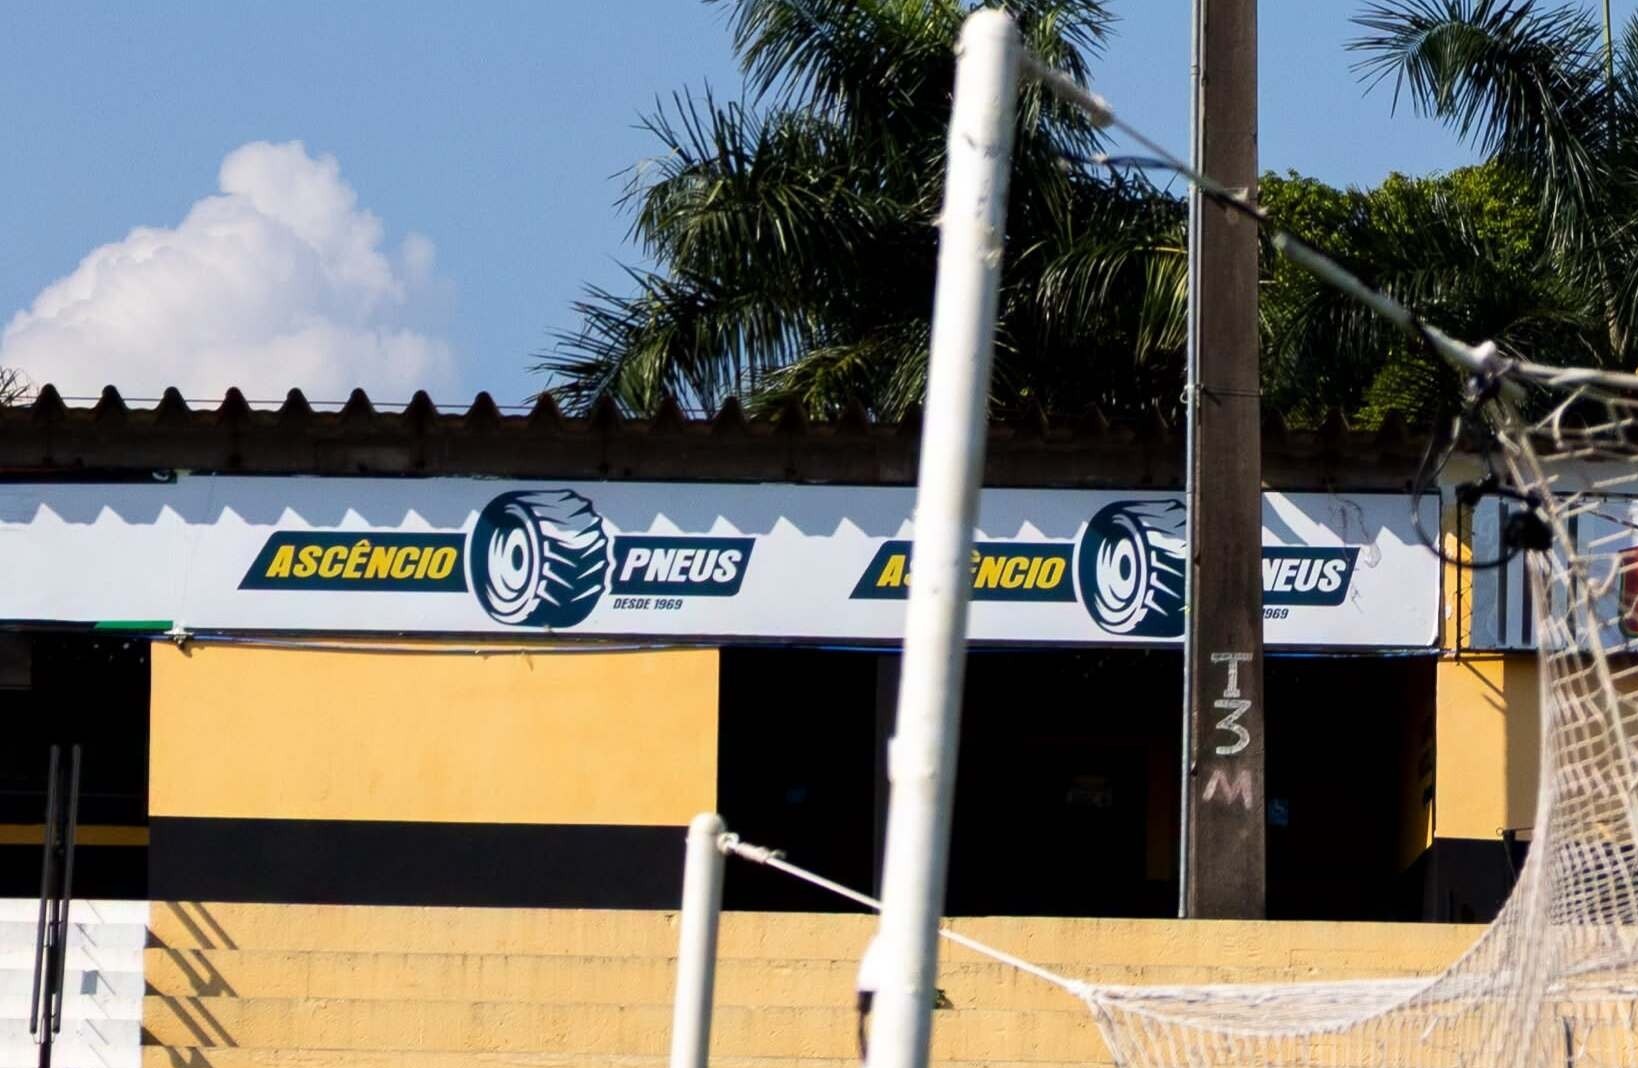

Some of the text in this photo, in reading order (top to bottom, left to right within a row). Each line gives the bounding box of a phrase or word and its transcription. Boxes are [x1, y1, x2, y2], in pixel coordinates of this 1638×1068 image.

[265, 540, 742, 583] ASCÊNCIO PNEUS
[876, 549, 1347, 592] ANCIO NEUS
[613, 598, 683, 610] DESDE 1969
[1262, 608, 1289, 620] 969
